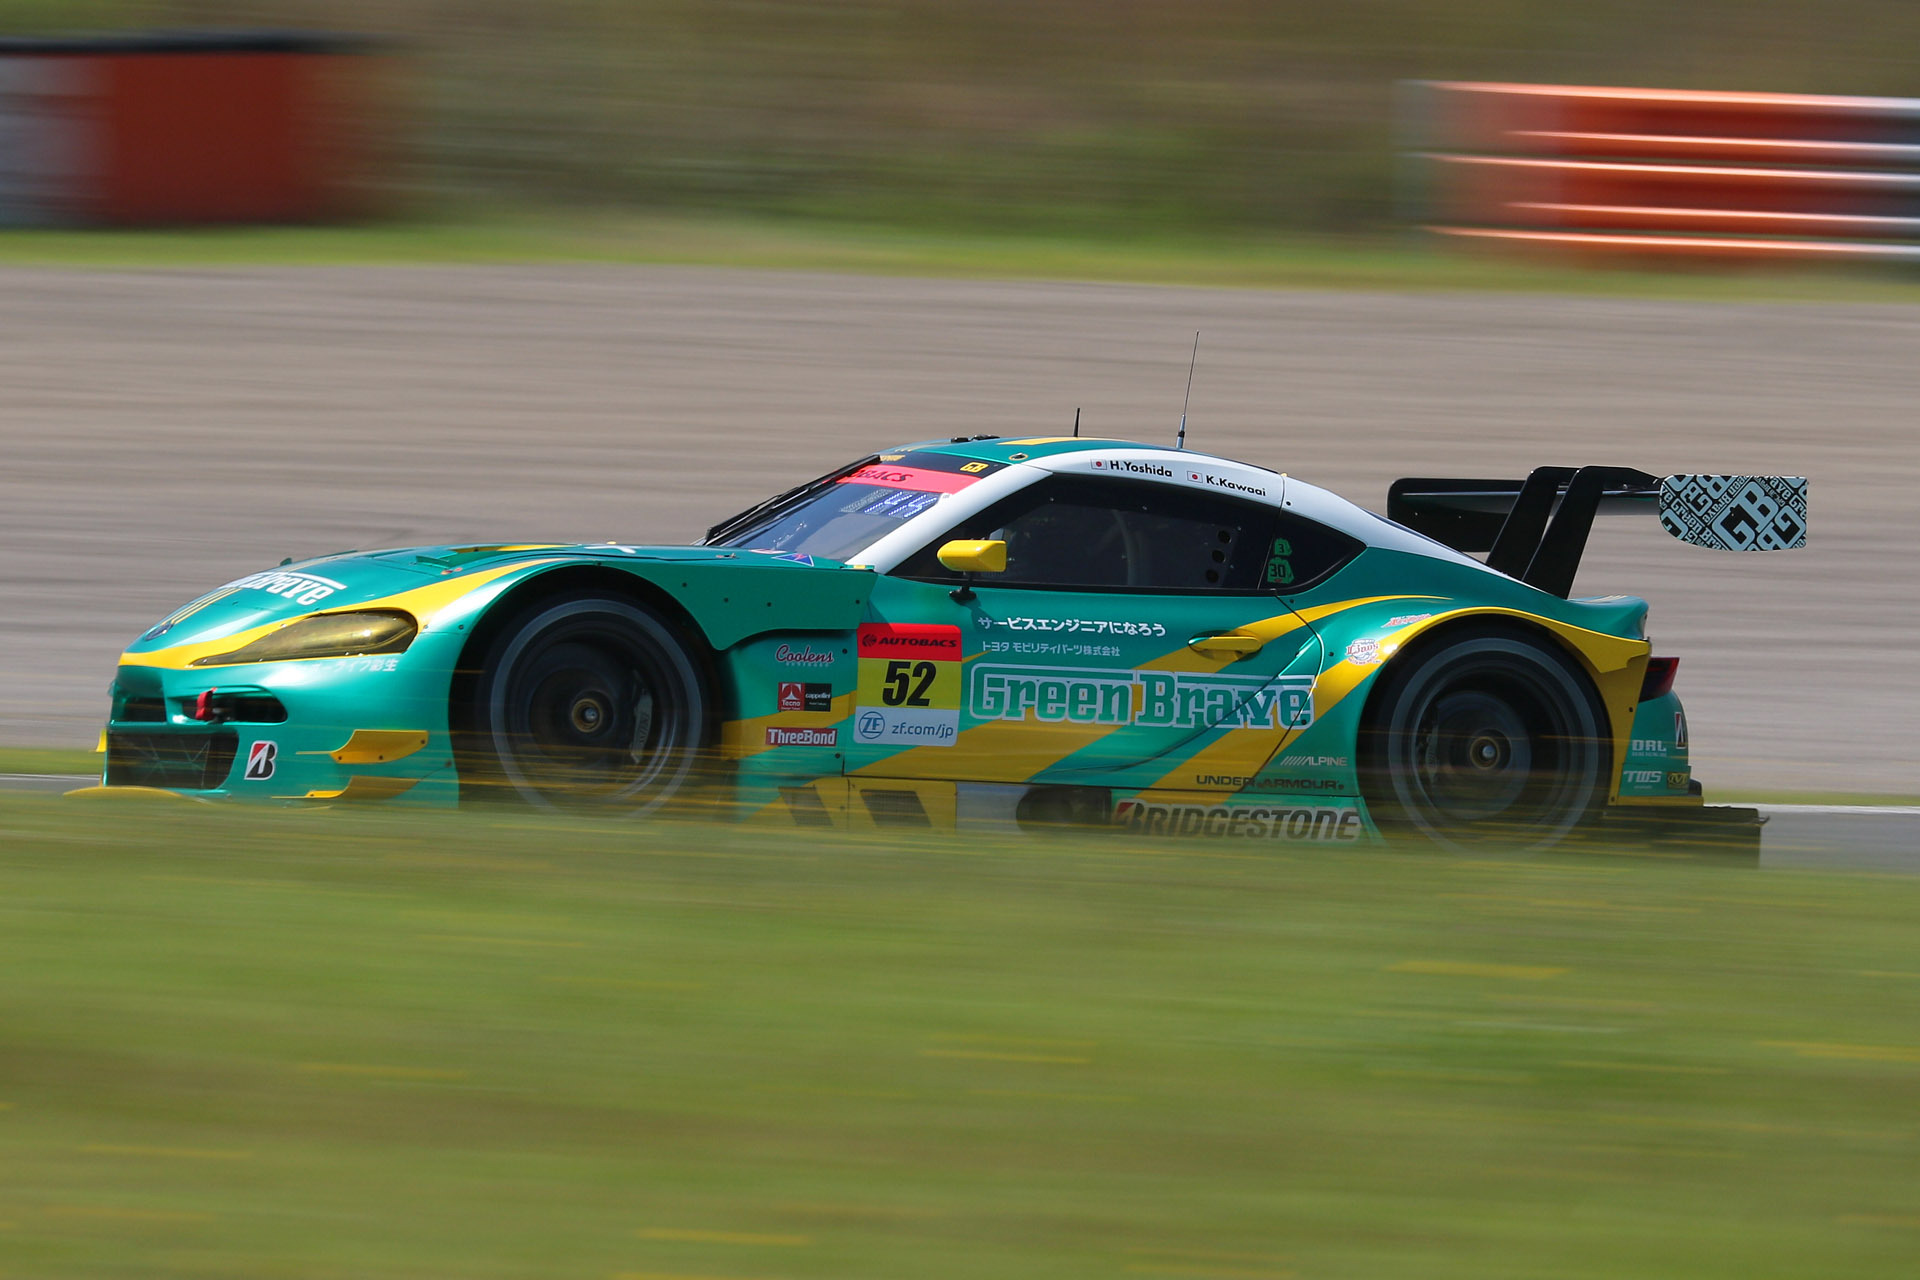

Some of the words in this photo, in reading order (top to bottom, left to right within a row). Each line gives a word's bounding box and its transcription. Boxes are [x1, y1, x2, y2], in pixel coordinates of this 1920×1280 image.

[1109, 460, 1173, 478] H.Yoshida
[1206, 475, 1267, 497] K.Kawaai
[1711, 481, 1779, 551] GB
[1269, 563, 1287, 578] 30
[977, 617, 1166, 638] サービスエンジニアになろう
[878, 637, 957, 648] AUTOBACS
[982, 641, 1010, 652] トヨタ
[776, 644, 835, 663] Coolens
[882, 661, 937, 706] 52
[782, 699, 801, 707] Tecno
[970, 663, 1132, 725] Green
[1134, 670, 1315, 730] Brave
[860, 714, 885, 736] ZF
[891, 722, 954, 739] zf.com/jp
[767, 728, 836, 745] ThreeBond
[1196, 775, 1256, 787] UNDER
[1259, 778, 1338, 790] ARMOUR
[1623, 771, 1663, 783] TWS
[1116, 802, 1360, 841] BRIDGESTONE
